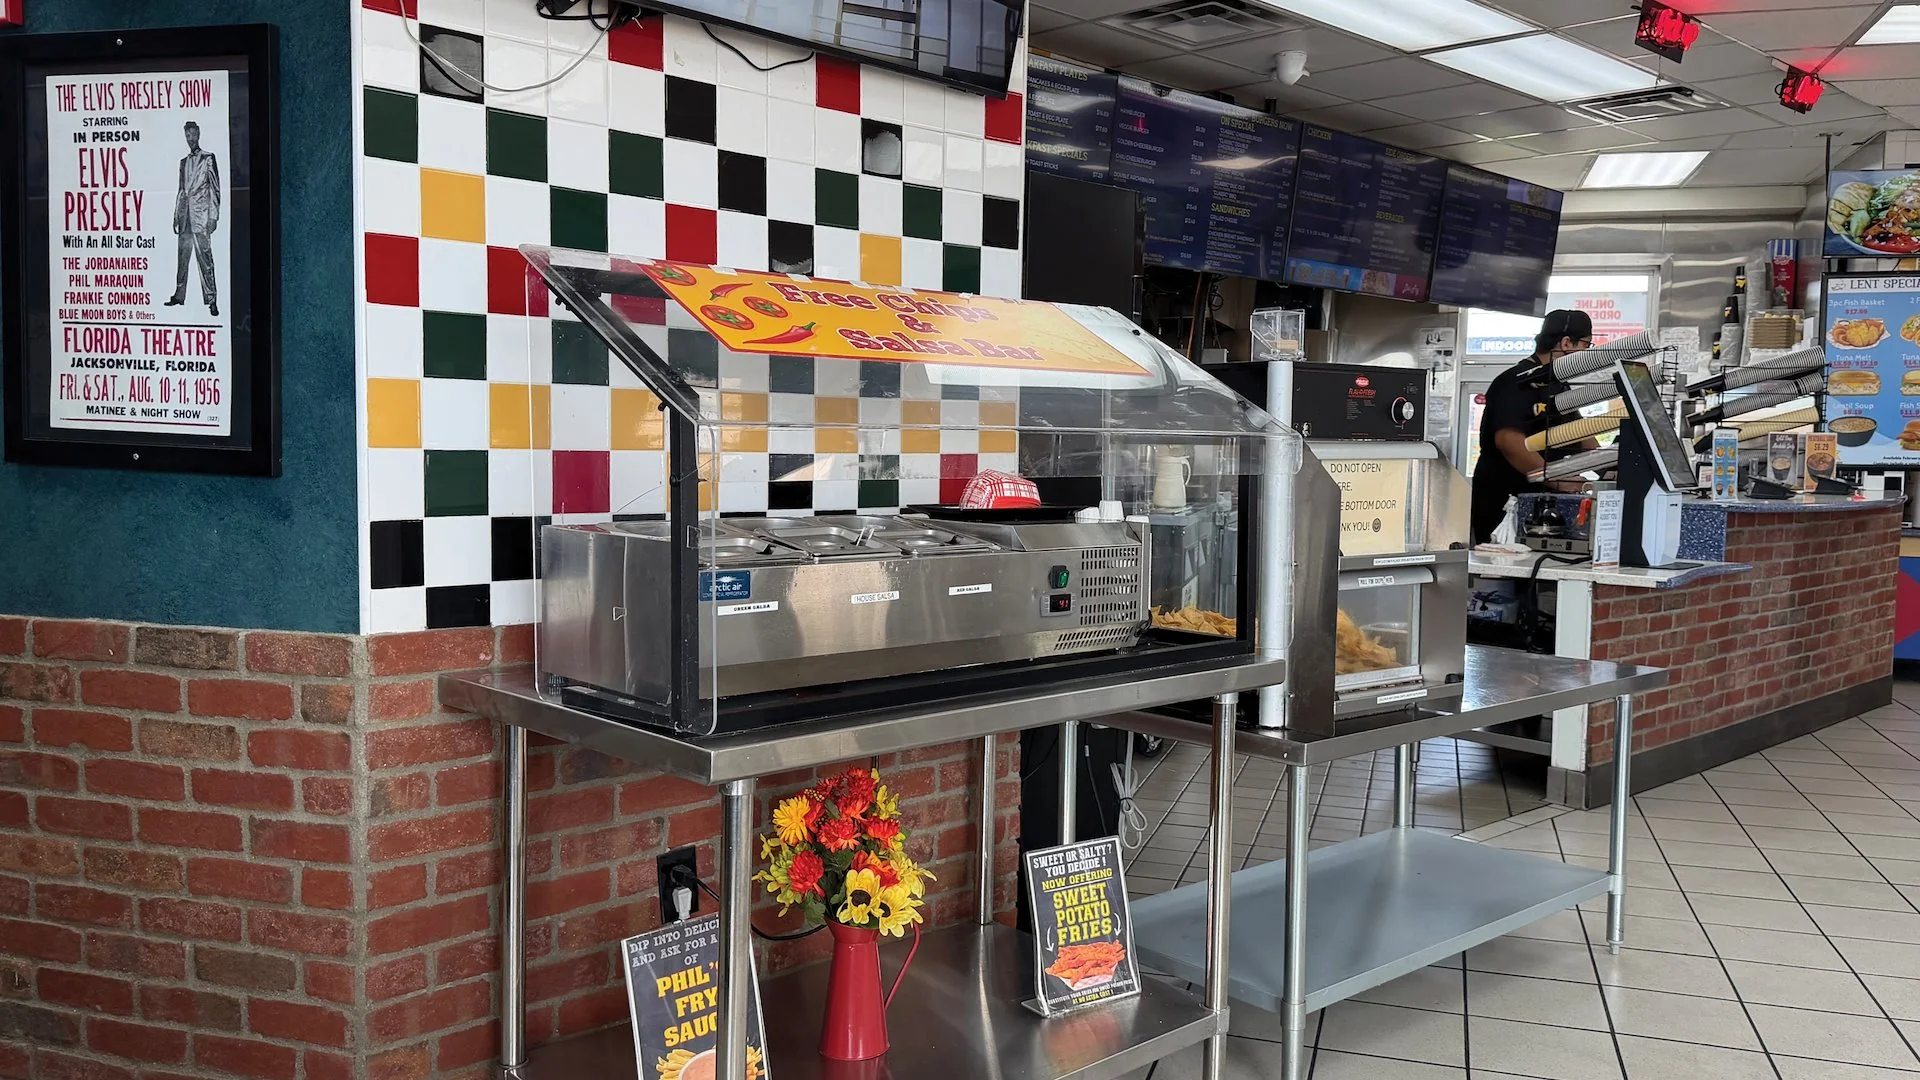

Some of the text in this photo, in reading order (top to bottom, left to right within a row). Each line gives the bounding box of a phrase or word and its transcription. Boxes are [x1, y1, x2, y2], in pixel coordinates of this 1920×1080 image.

[1061, 65, 1088, 80] PLATES
[56, 79, 211, 112] THE ELVIS PRESLEY SHOW
[1067, 84, 1080, 94] PLATE
[82, 117, 128, 127] STARRING
[1055, 116, 1069, 124] PLATE
[1221, 116, 1255, 132] ON SPECIAL
[74, 131, 140, 143] IN PERSON
[1051, 145, 1088, 161] SPECIALS
[79, 147, 129, 188] ELVIS
[1029, 159, 1059, 170] TOAST STICKS
[64, 190, 143, 231] PRESLEY
[1211, 203, 1250, 217] SANDWICHES
[63, 235, 155, 248] With An All Star Cast
[63, 257, 148, 270] THE JORDANAIRES
[69, 275, 143, 289] PHIL MARAQUIN
[1850, 280, 1879, 289] LENT
[64, 292, 150, 305] FRANKIE CONNORS
[766, 282, 998, 323] Free Chips
[59, 309, 155, 320] BLUE MOON BOYS & Others
[896, 313, 942, 335] &
[64, 327, 216, 356] FLORIDA THEATRE
[837, 327, 1047, 361] Salsa Bar
[70, 357, 216, 373] JACKSONVILLE, FLORIDA
[60, 374, 220, 405] FRI. & SAT., AUG. 1956
[86, 405, 201, 419] MATINEE & NIGHT SHOW
[1331, 463, 1381, 473] DO NOT OPEN
[1345, 501, 1374, 510] BOTTOM
[1375, 500, 1397, 509] DOOR
[1352, 521, 1370, 530] YOU!
[709, 583, 731, 592] arctic
[856, 592, 895, 602] HOUSE SALSA
[1033, 844, 1112, 869] SWEET OR SALTY?
[1045, 864, 1066, 877] YOU
[1068, 860, 1100, 874] DECIDE
[1042, 868, 1113, 890] NOW OFFERING
[1053, 883, 1107, 910] SWEET
[1056, 900, 1110, 928] POTATO
[1057, 917, 1112, 945] FRIES
[629, 940, 649, 954] DIP
[654, 931, 680, 946] INTO
[632, 934, 718, 968] AND ASK FOR A
[684, 954, 699, 966] OF
[675, 987, 718, 1018] FRY
